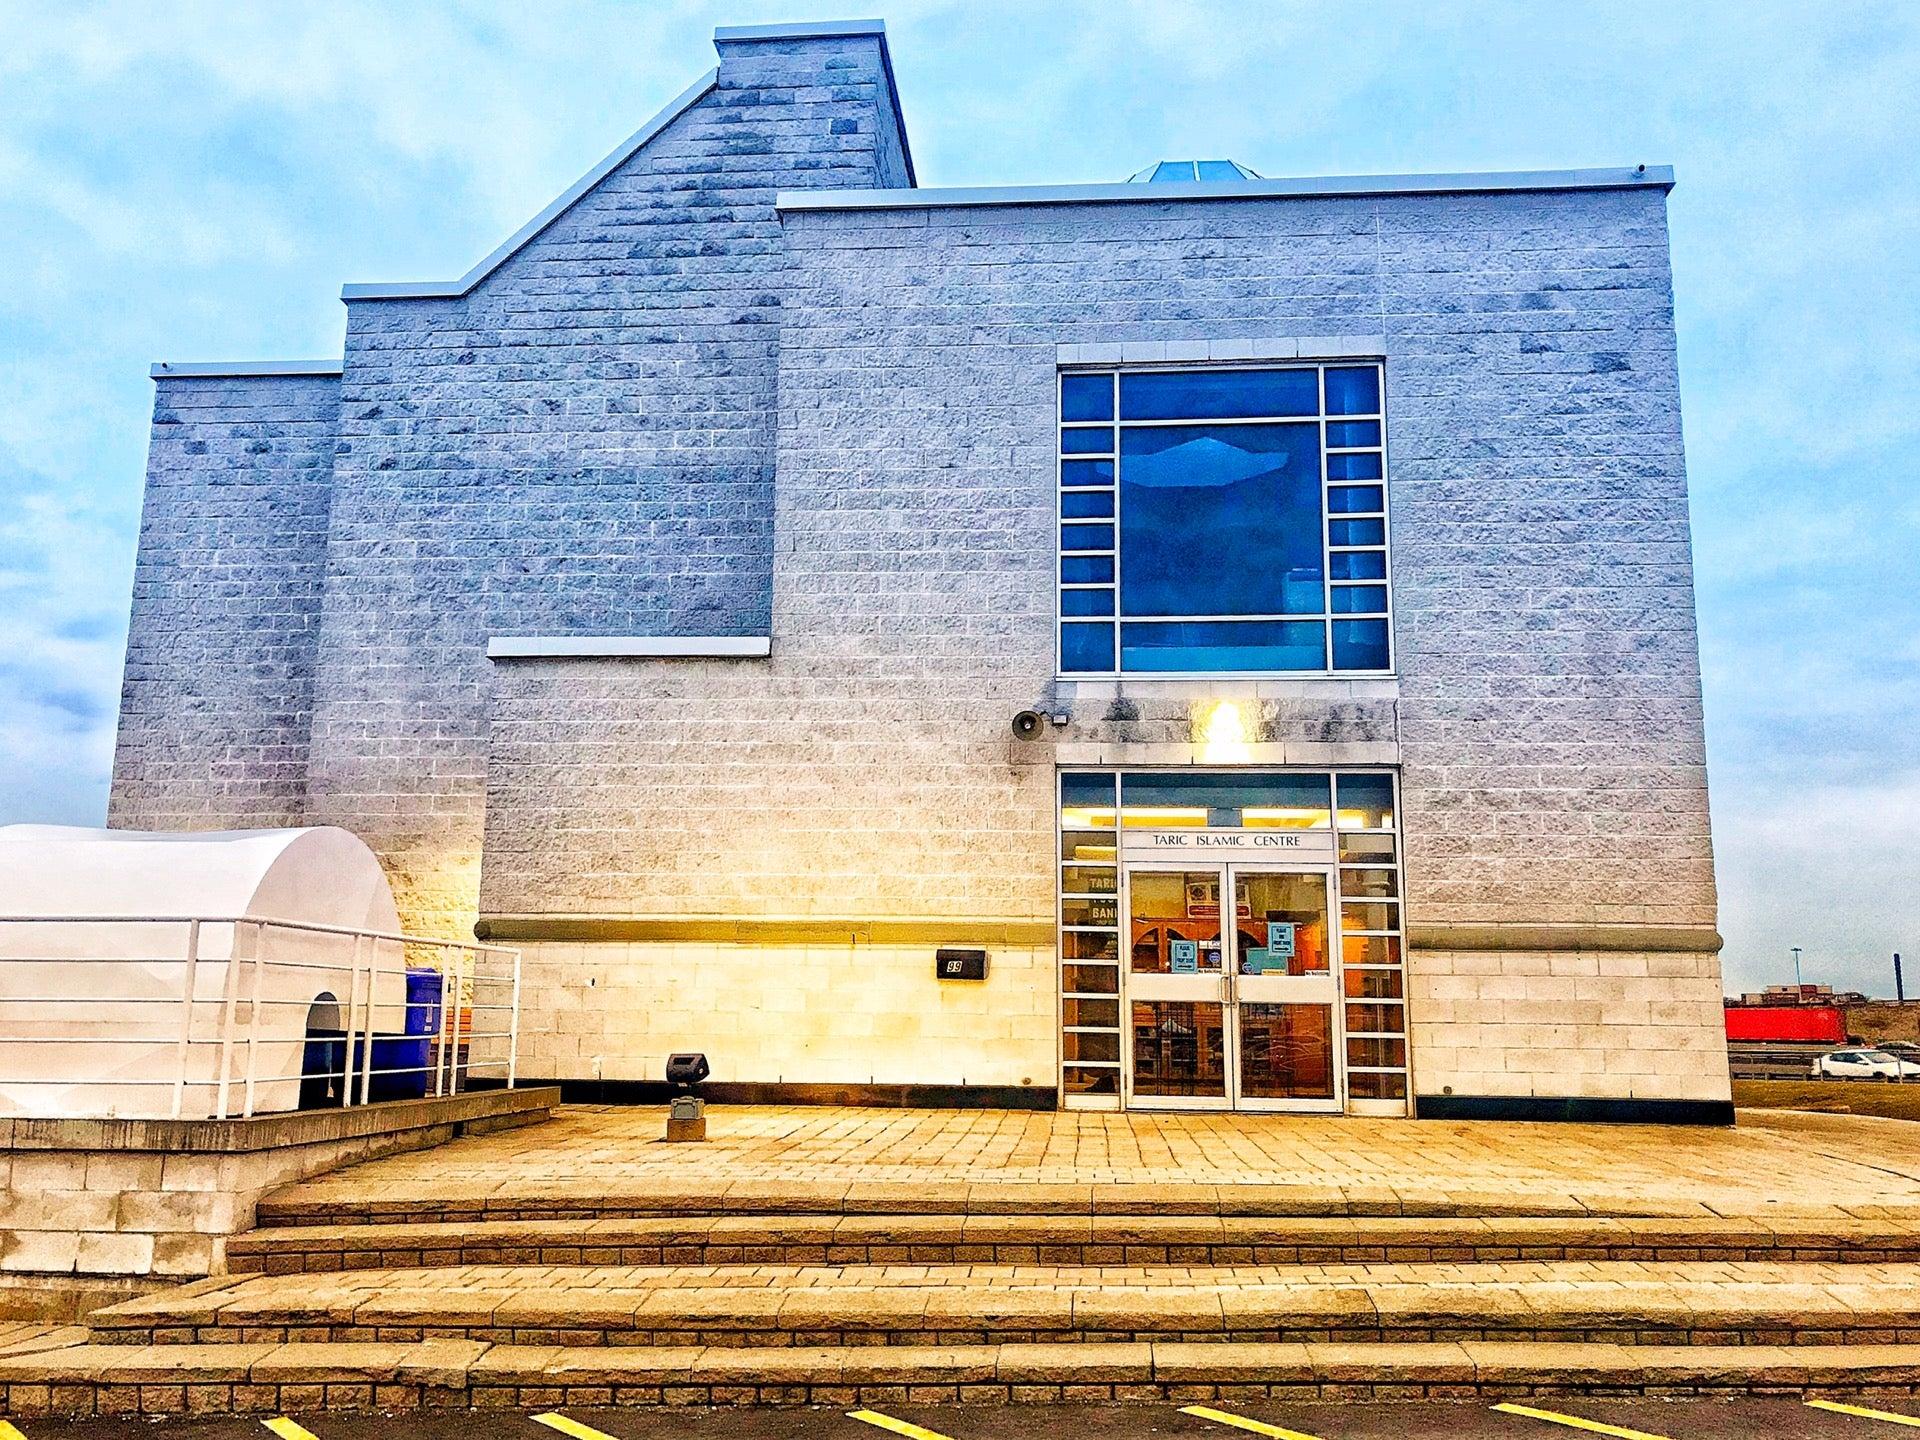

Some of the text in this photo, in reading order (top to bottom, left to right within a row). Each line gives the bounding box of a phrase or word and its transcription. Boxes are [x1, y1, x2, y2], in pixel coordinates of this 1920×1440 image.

[1153, 834, 1301, 847] TARIC ISLAMIC CENTRE
[1090, 877, 1117, 889] TARI
[947, 960, 962, 972] 99
